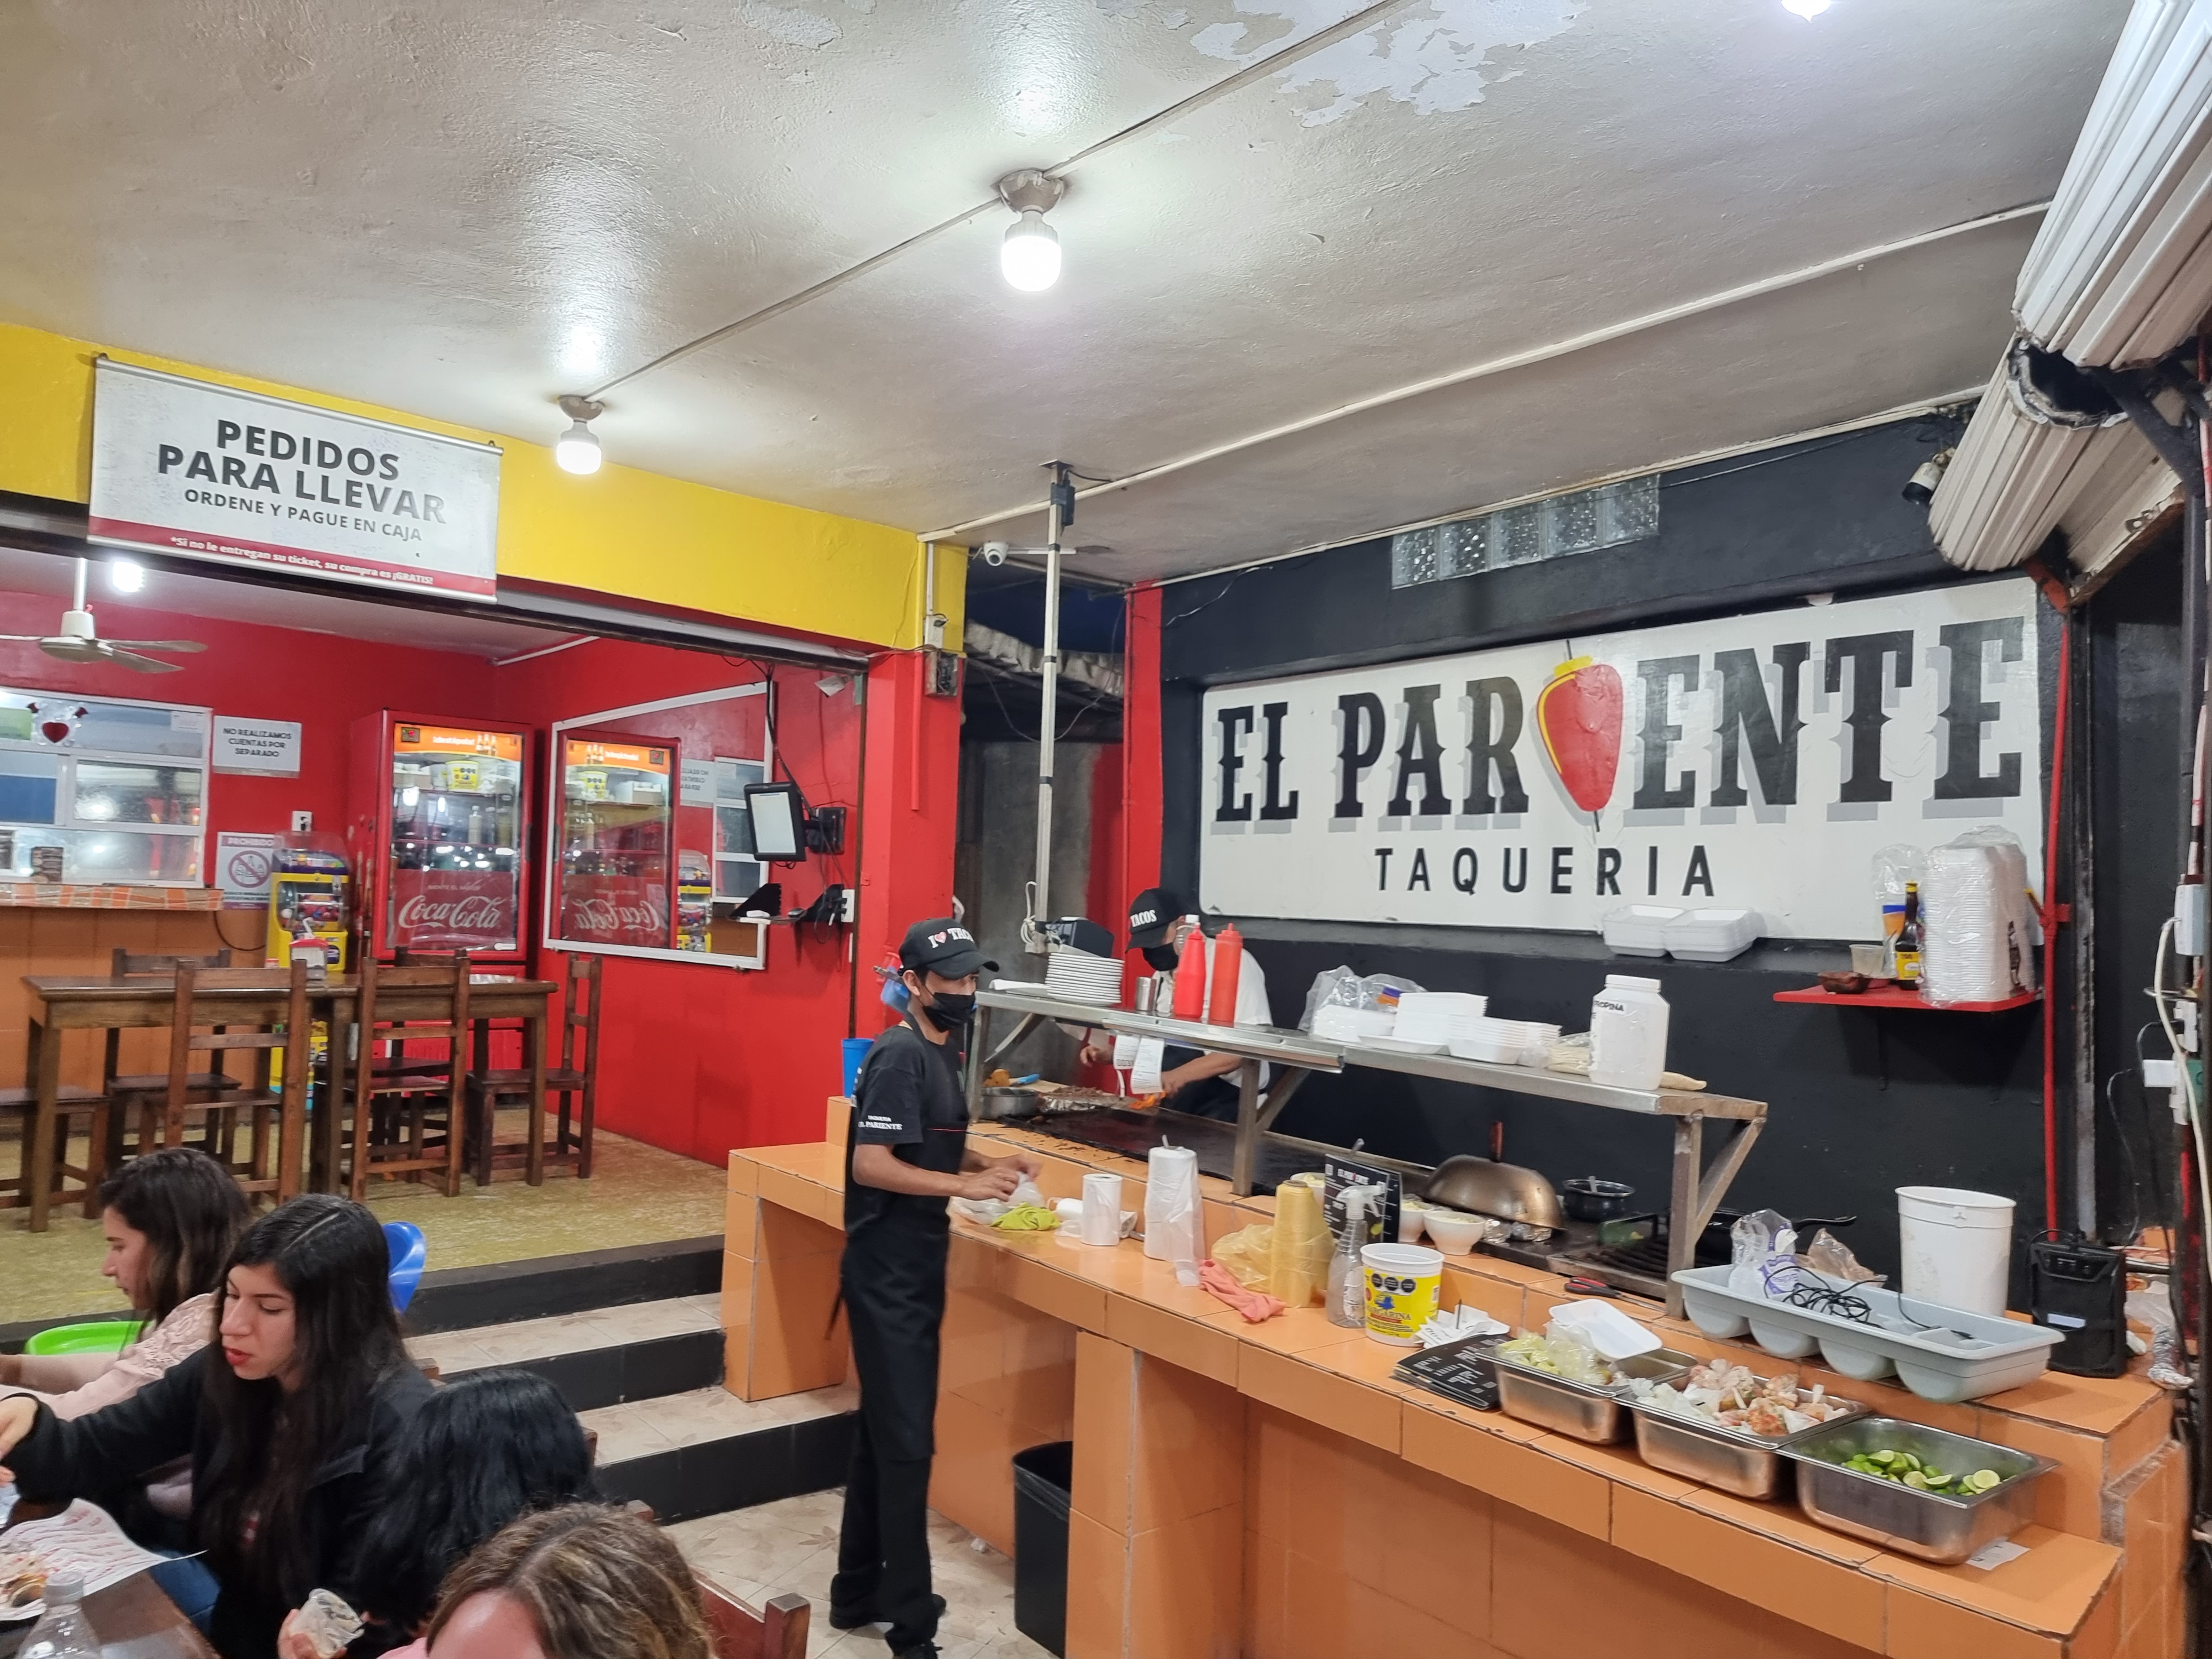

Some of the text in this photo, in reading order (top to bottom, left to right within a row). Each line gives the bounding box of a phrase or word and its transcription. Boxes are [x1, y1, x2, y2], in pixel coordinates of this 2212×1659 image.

[217, 420, 399, 481] PEDIDOS
[158, 444, 446, 524] PARA LLEVAR
[185, 489, 422, 542] ORDENE Y PAGUE EN CAJA
[190, 541, 205, 551] no
[207, 541, 218, 552] le
[220, 545, 272, 561] entregan
[273, 553, 286, 563] su
[289, 554, 323, 569] ticket,
[325, 561, 338, 570] su
[339, 564, 378, 578] compra
[379, 570, 392, 579] es
[228, 738, 267, 747] CUENTAS
[238, 729, 292, 739] REALIZAMOS
[235, 748, 280, 757] SEPARADO
[1216, 701, 1299, 822] EL
[1375, 846, 1715, 896] TAQUERIA
[398, 895, 508, 928] Coca-Cola
[1130, 909, 1157, 927] TACOS
[928, 935, 939, 949] I
